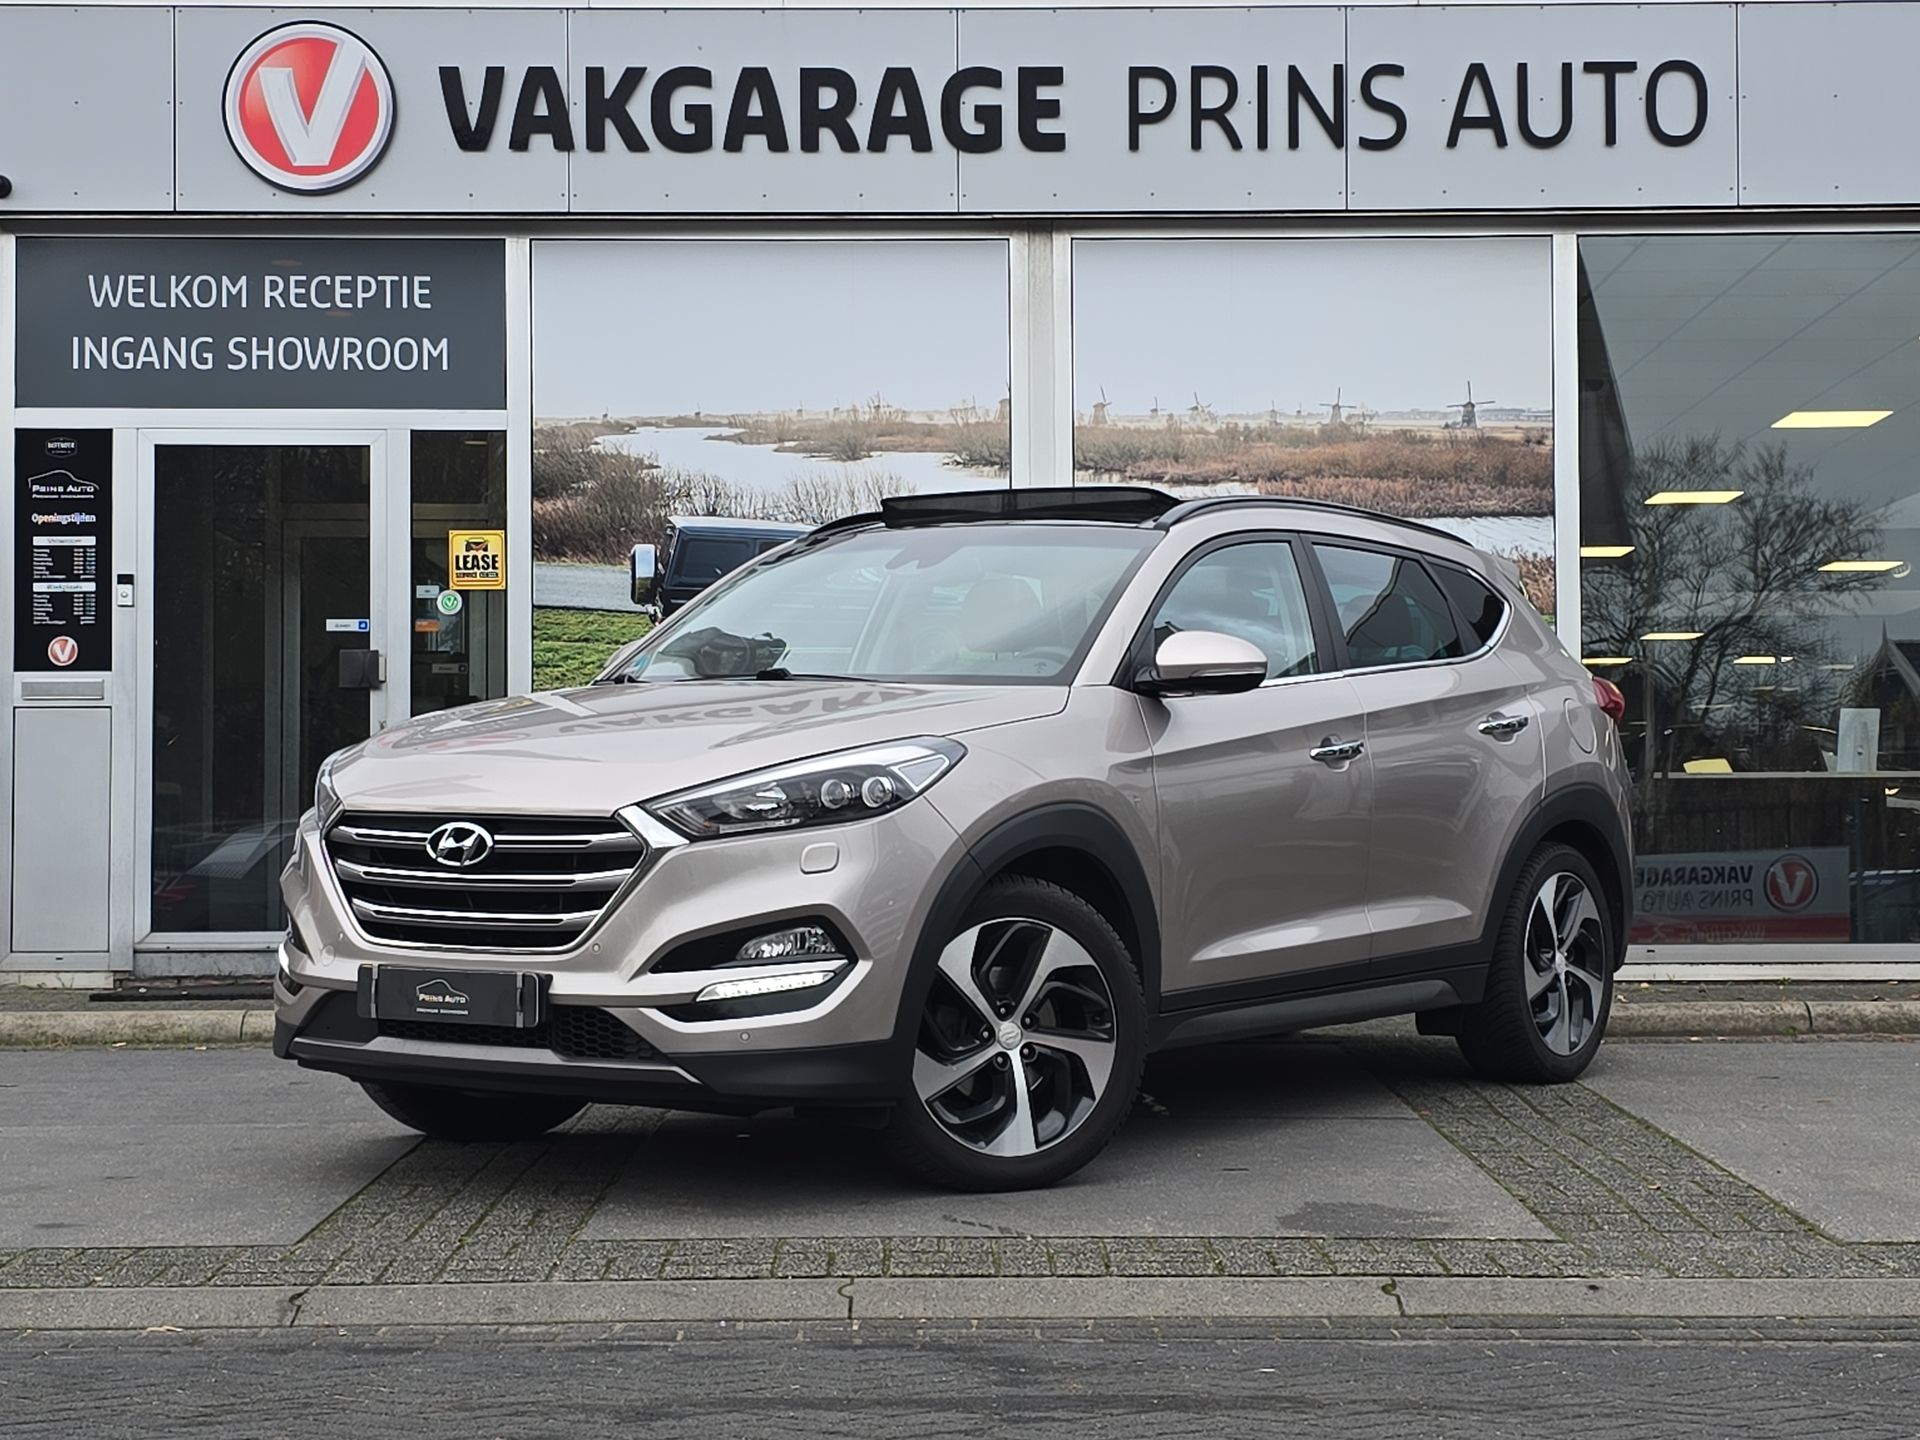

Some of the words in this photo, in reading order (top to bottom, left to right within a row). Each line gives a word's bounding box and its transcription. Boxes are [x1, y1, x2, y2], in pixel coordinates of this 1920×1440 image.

[438, 66, 1066, 153] VAKGARAGE
[1127, 63, 1408, 152] PRINS
[1446, 59, 1709, 149] AUTO
[88, 274, 248, 309] WELKOM
[264, 274, 432, 309] RECEPTIE
[72, 336, 214, 371] INGANG
[227, 336, 449, 371] SHOWROOM
[31, 513, 96, 524] Openingstijden
[455, 554, 499, 571] LEASE
